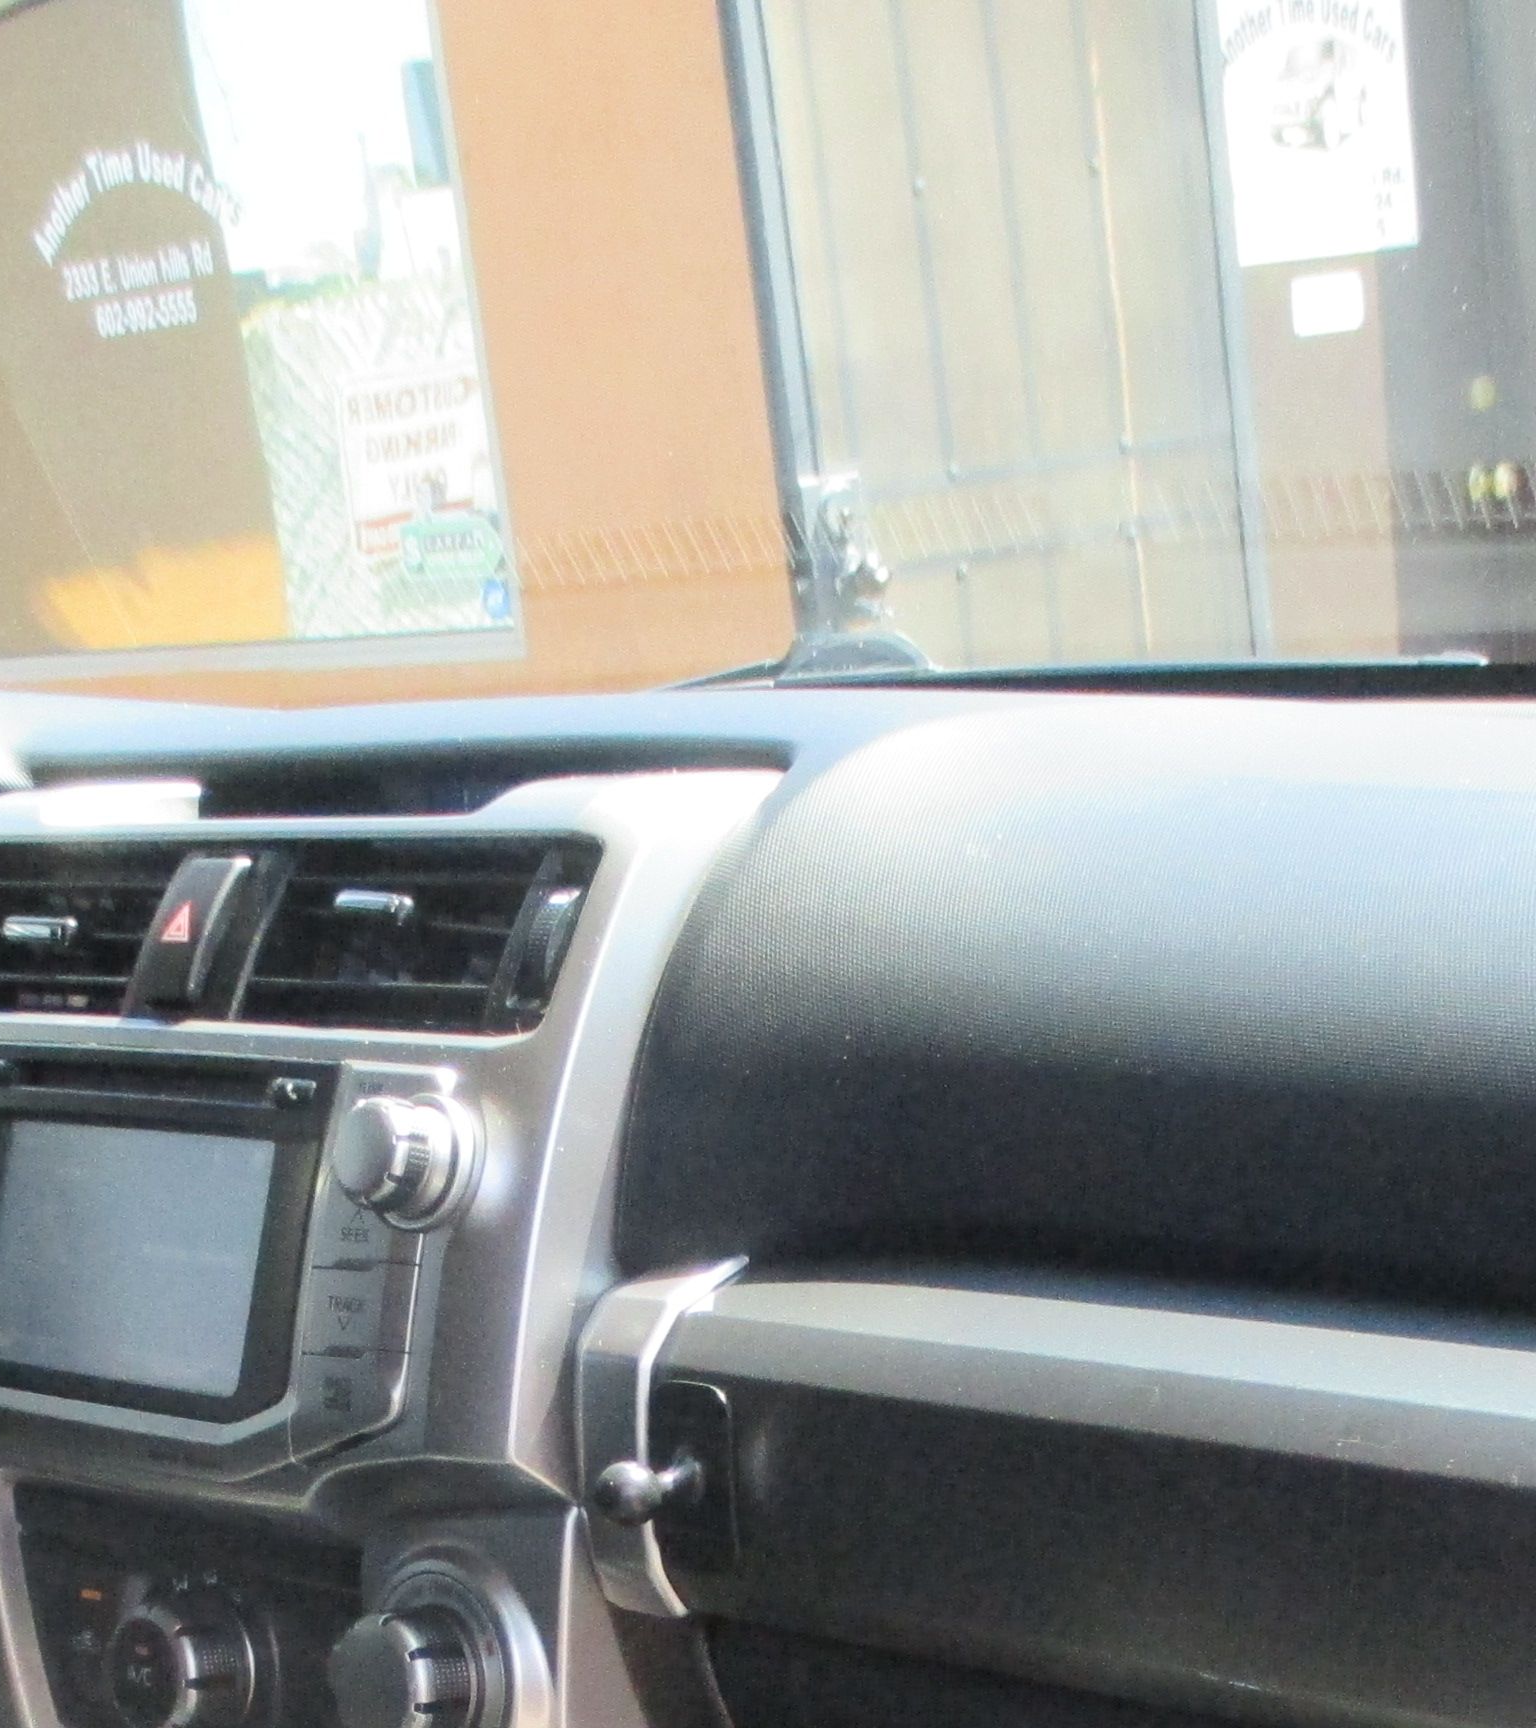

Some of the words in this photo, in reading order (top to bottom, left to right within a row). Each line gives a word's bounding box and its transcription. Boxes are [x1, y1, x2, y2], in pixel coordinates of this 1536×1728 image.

[1224, 5, 1272, 66] nother
[1363, 6, 1397, 64] Cars
[32, 168, 91, 269] Another
[84, 147, 135, 194] Time
[135, 141, 186, 194] Used
[116, 254, 159, 292] Union
